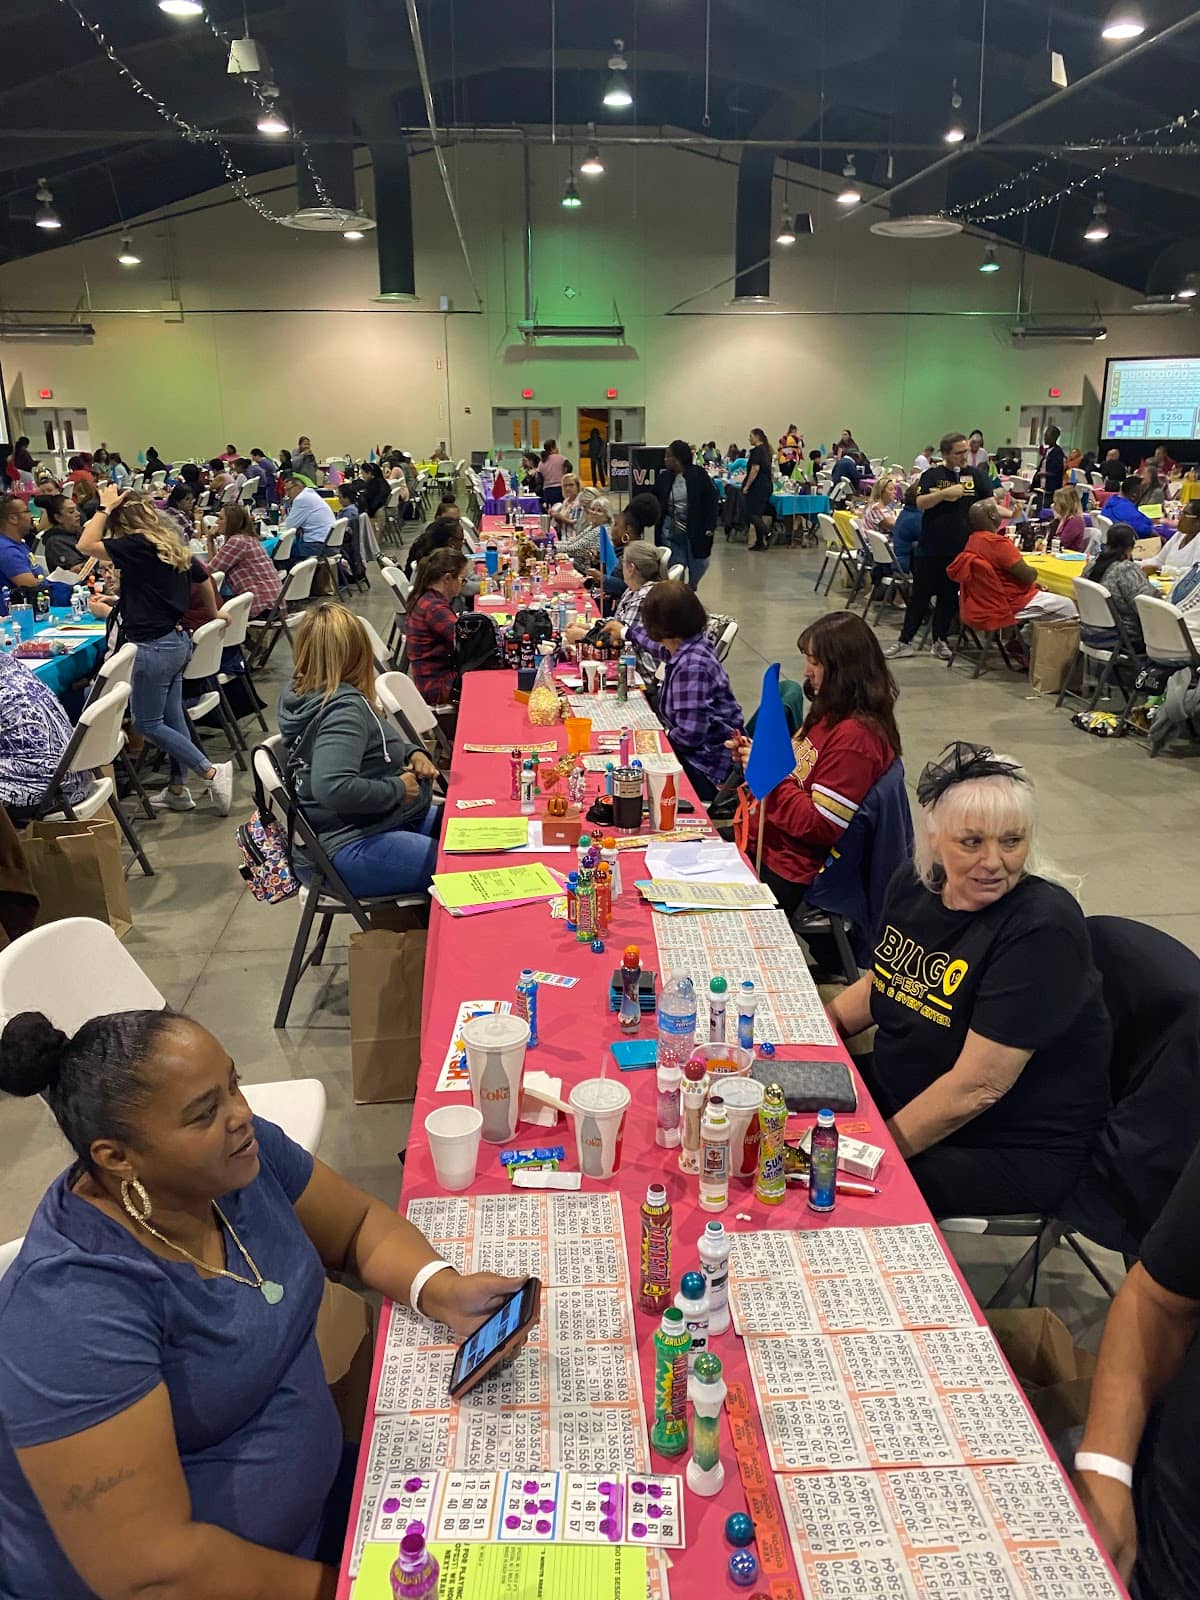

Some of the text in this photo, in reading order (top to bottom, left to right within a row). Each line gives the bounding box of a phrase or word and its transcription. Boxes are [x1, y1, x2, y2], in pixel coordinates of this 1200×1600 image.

[1161, 413, 1182, 421] $250
[891, 972, 929, 999] FEST
[574, 1357, 583, 1365] 23
[588, 1356, 597, 1365] 26
[601, 1356, 610, 1364] 17
[615, 1355, 624, 1364] 25
[560, 1347, 571, 1402] 13 20 33 59 74
[575, 1368, 584, 1376] 41
[602, 1367, 612, 1376] 35
[616, 1367, 625, 1376] 32
[576, 1380, 585, 1389] 54
[590, 1379, 599, 1388] 51
[603, 1379, 613, 1389] 56
[617, 1379, 627, 1388] 58
[576, 1392, 586, 1401] 62
[590, 1392, 600, 1401] 70
[604, 1391, 614, 1401] 68
[618, 1391, 628, 1400] 63
[773, 1403, 784, 1412] 61
[787, 1401, 798, 1412] 64
[801, 1401, 812, 1410] 72
[829, 1400, 840, 1410] 62
[776, 1415, 787, 1425] 58
[790, 1414, 801, 1424] 56
[804, 1413, 815, 1424] 59
[833, 1413, 844, 1423] 51
[779, 1427, 790, 1439] 35
[793, 1427, 804, 1438] 40
[815, 1400, 841, 1464] 10 27 36 57 65
[837, 1426, 848, 1436] 33
[782, 1441, 792, 1451] 17
[811, 1440, 823, 1451] 20
[840, 1439, 852, 1450] 16
[800, 1455, 811, 1465] 14
[840, 1476, 851, 1488] 65
[854, 1476, 867, 1487] 67
[904, 1472, 917, 1484] 75
[919, 1472, 931, 1483] 65
[794, 1478, 806, 1490] 69
[509, 1480, 522, 1510] 22 26
[844, 1491, 856, 1503] 60
[859, 1490, 871, 1502] 46
[909, 1487, 922, 1499] 55
[924, 1487, 937, 1498] 57
[415, 1498, 426, 1508] 31
[448, 1500, 458, 1509] 40
[474, 1480, 490, 1529] 15 29 51
[798, 1493, 809, 1505] 48
[381, 1480, 402, 1530] 16 69
[459, 1480, 476, 1530] 12 50 69
[570, 1500, 581, 1511] 47
[585, 1482, 596, 1532] 11 46 67
[915, 1502, 927, 1515] 40
[933, 1471, 972, 1544] 13 17 42 54 70
[396, 1498, 412, 1530] 37 66
[802, 1508, 813, 1521] 43
[809, 1478, 839, 1552] 14 28 32 57 62
[824, 1477, 855, 1551] 13 23 50 64
[849, 1507, 860, 1518] 41
[864, 1505, 877, 1518] 38
[444, 1518, 455, 1530] 60
[521, 1520, 533, 1531] 73
[570, 1521, 580, 1532] 57
[853, 1522, 866, 1534] 30
[869, 1521, 882, 1533] 19
[921, 1517, 933, 1529] 16
[936, 1517, 950, 1529] 27
[648, 1524, 658, 1534] 61
[806, 1524, 819, 1537] 20
[442, 1549, 451, 1570] NEXT
[449, 1572, 456, 1584] WE
